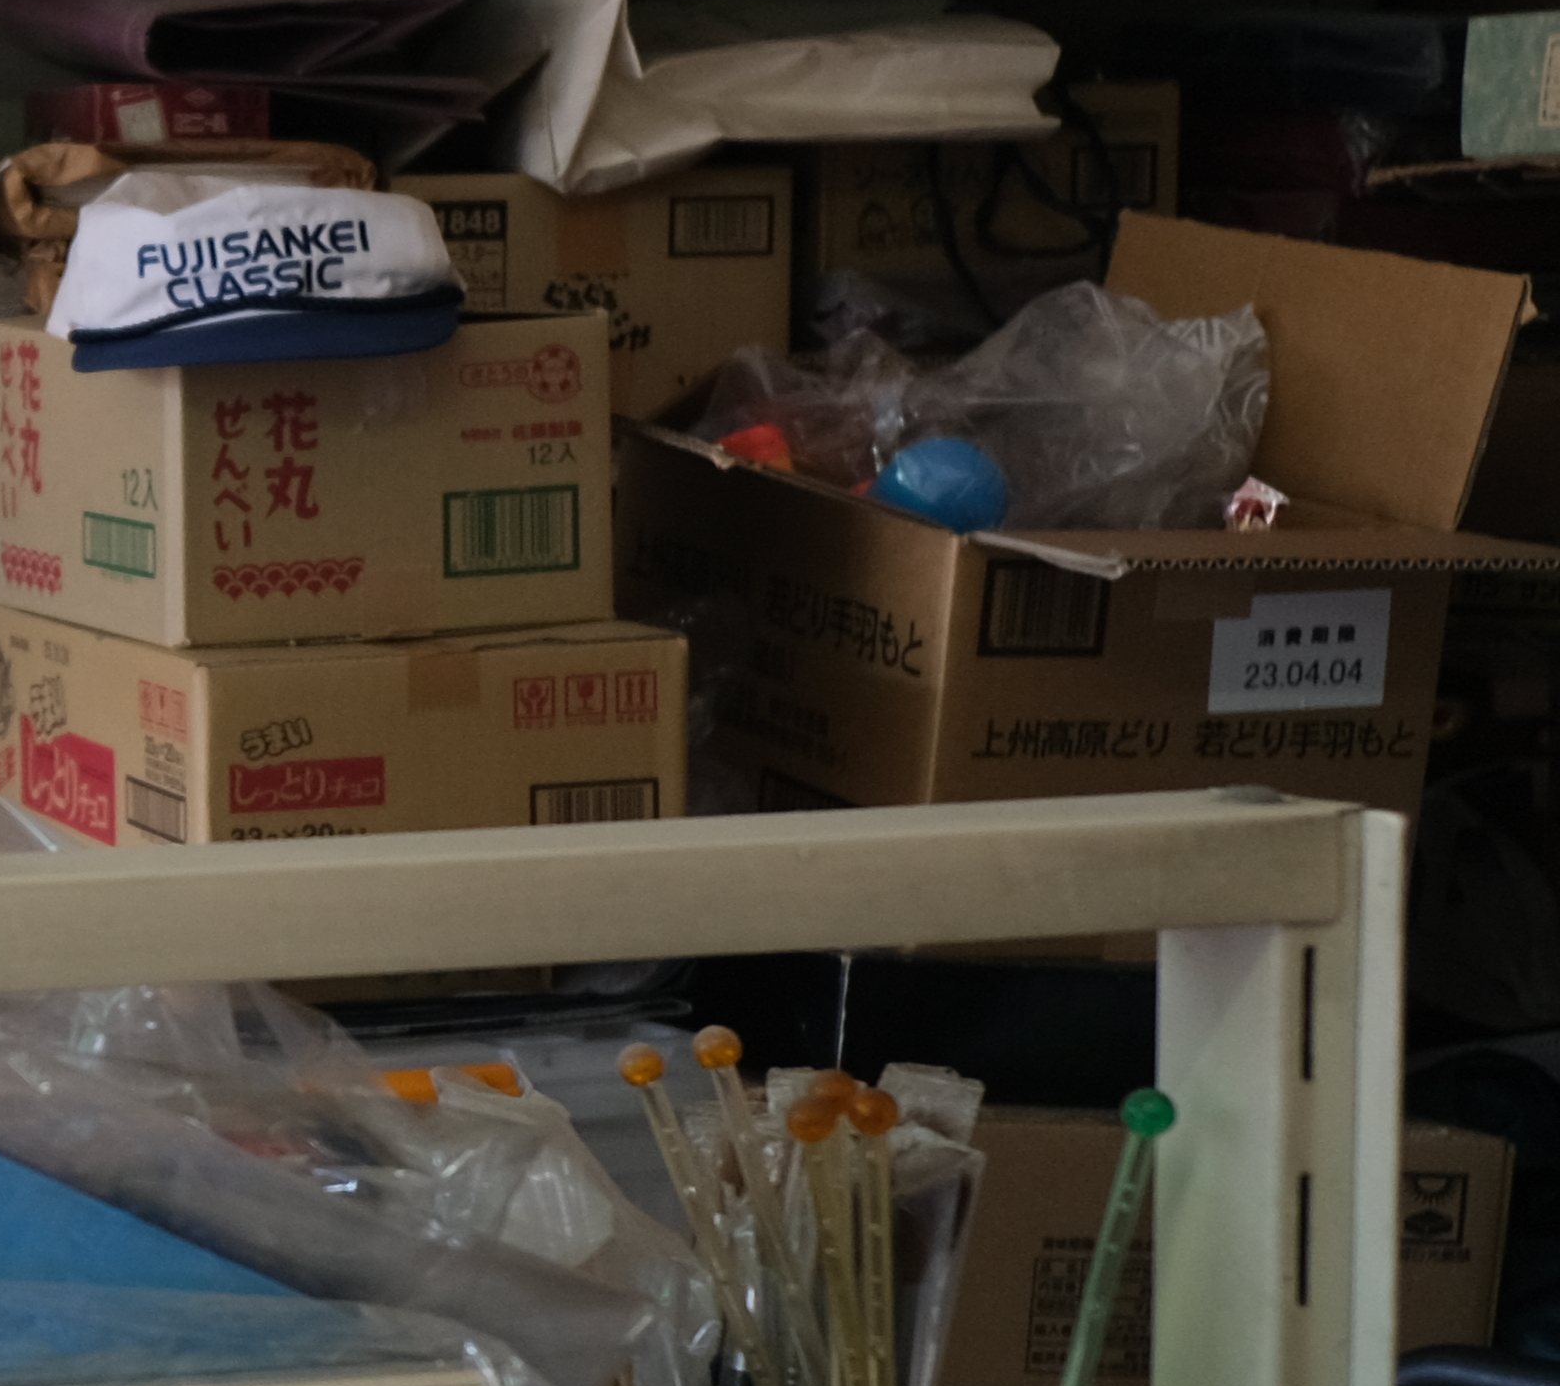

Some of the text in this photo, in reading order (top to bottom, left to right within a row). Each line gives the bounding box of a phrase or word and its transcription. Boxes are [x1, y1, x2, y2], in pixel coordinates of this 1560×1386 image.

[137, 219, 371, 280] FUJISANKEI
[166, 257, 344, 311] CLASSIC
[0, 342, 18, 520] せんべい
[17, 340, 43, 497] 花丸
[211, 396, 253, 551] せんべい
[262, 391, 321, 521] 花丸
[526, 442, 578, 466] 12入
[120, 467, 159, 511] 12入
[1257, 623, 1356, 649] 消費期限
[1243, 658, 1364, 691] 23.04.04
[239, 716, 314, 761] うまい
[971, 719, 1416, 760] 上州高原どり 若どり手羽もと
[234, 765, 383, 807] しっとりチョコ
